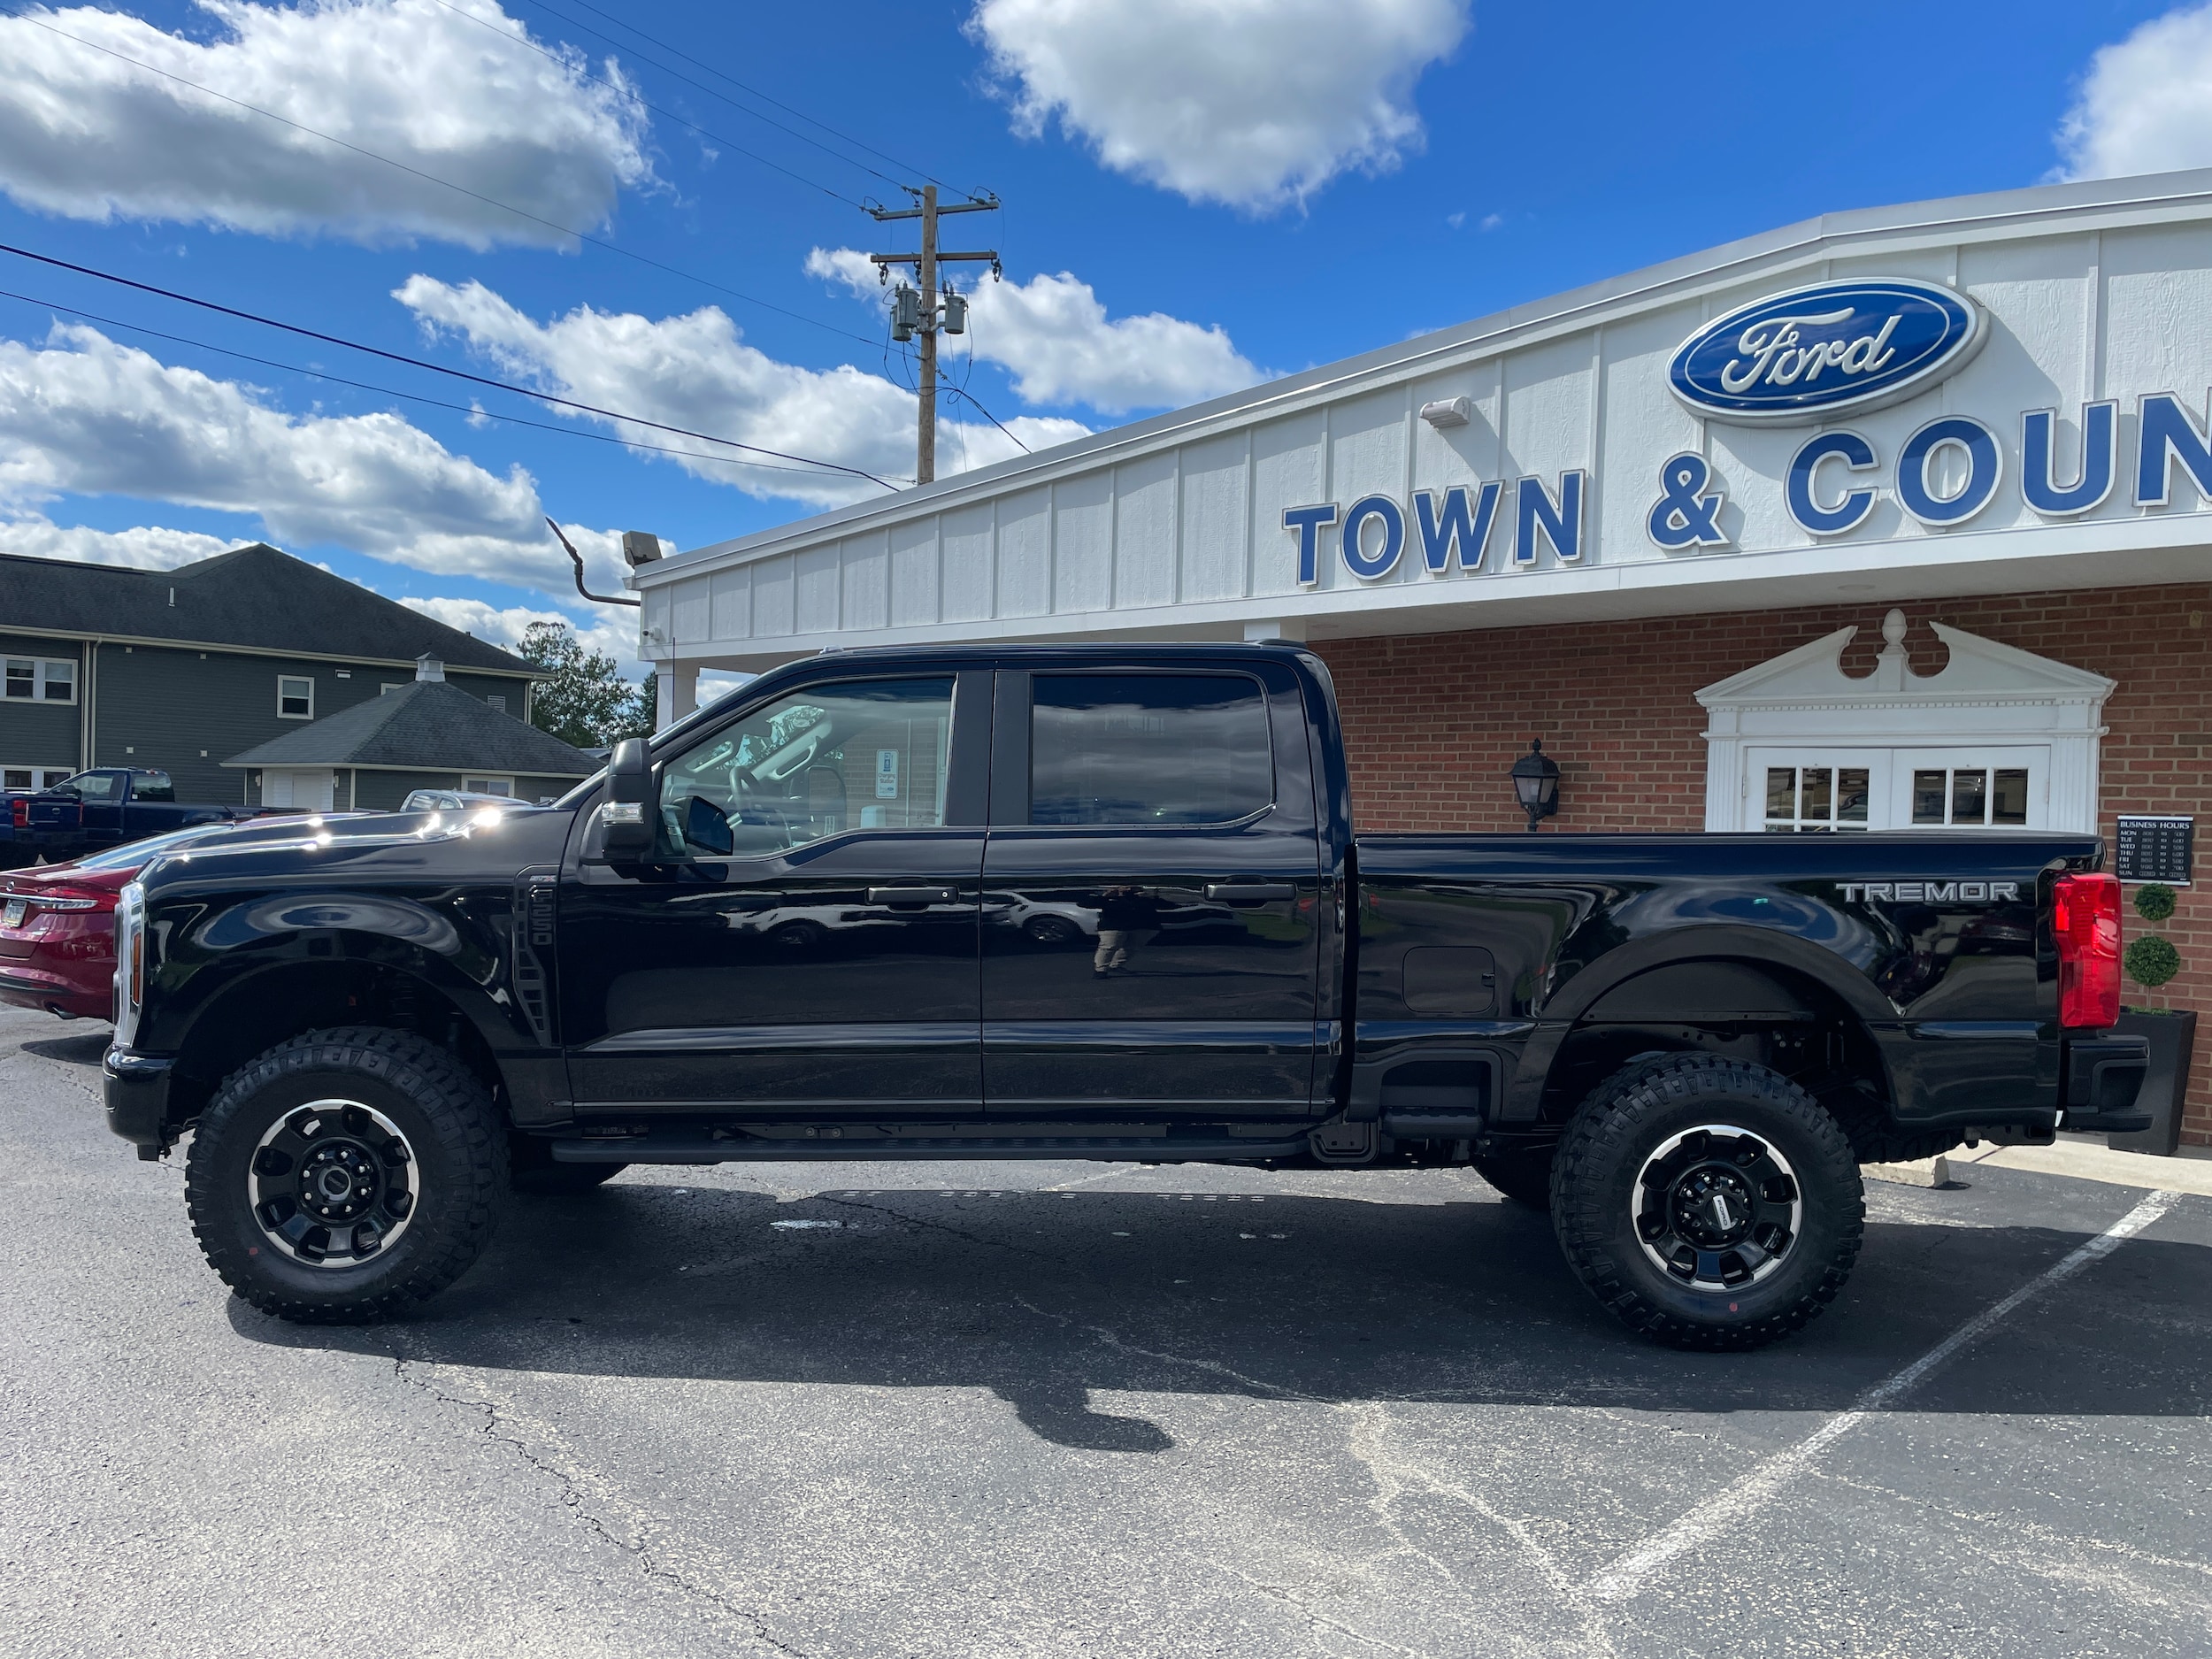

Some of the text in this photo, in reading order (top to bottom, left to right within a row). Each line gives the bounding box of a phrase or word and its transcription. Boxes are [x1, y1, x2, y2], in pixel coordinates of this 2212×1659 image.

[1721, 306, 1902, 395] Ford
[1282, 468, 1586, 587] TOWN
[1647, 450, 1732, 550] &
[1836, 882, 2022, 902] TREMOR
[1717, 1200, 1728, 1226] FORD
